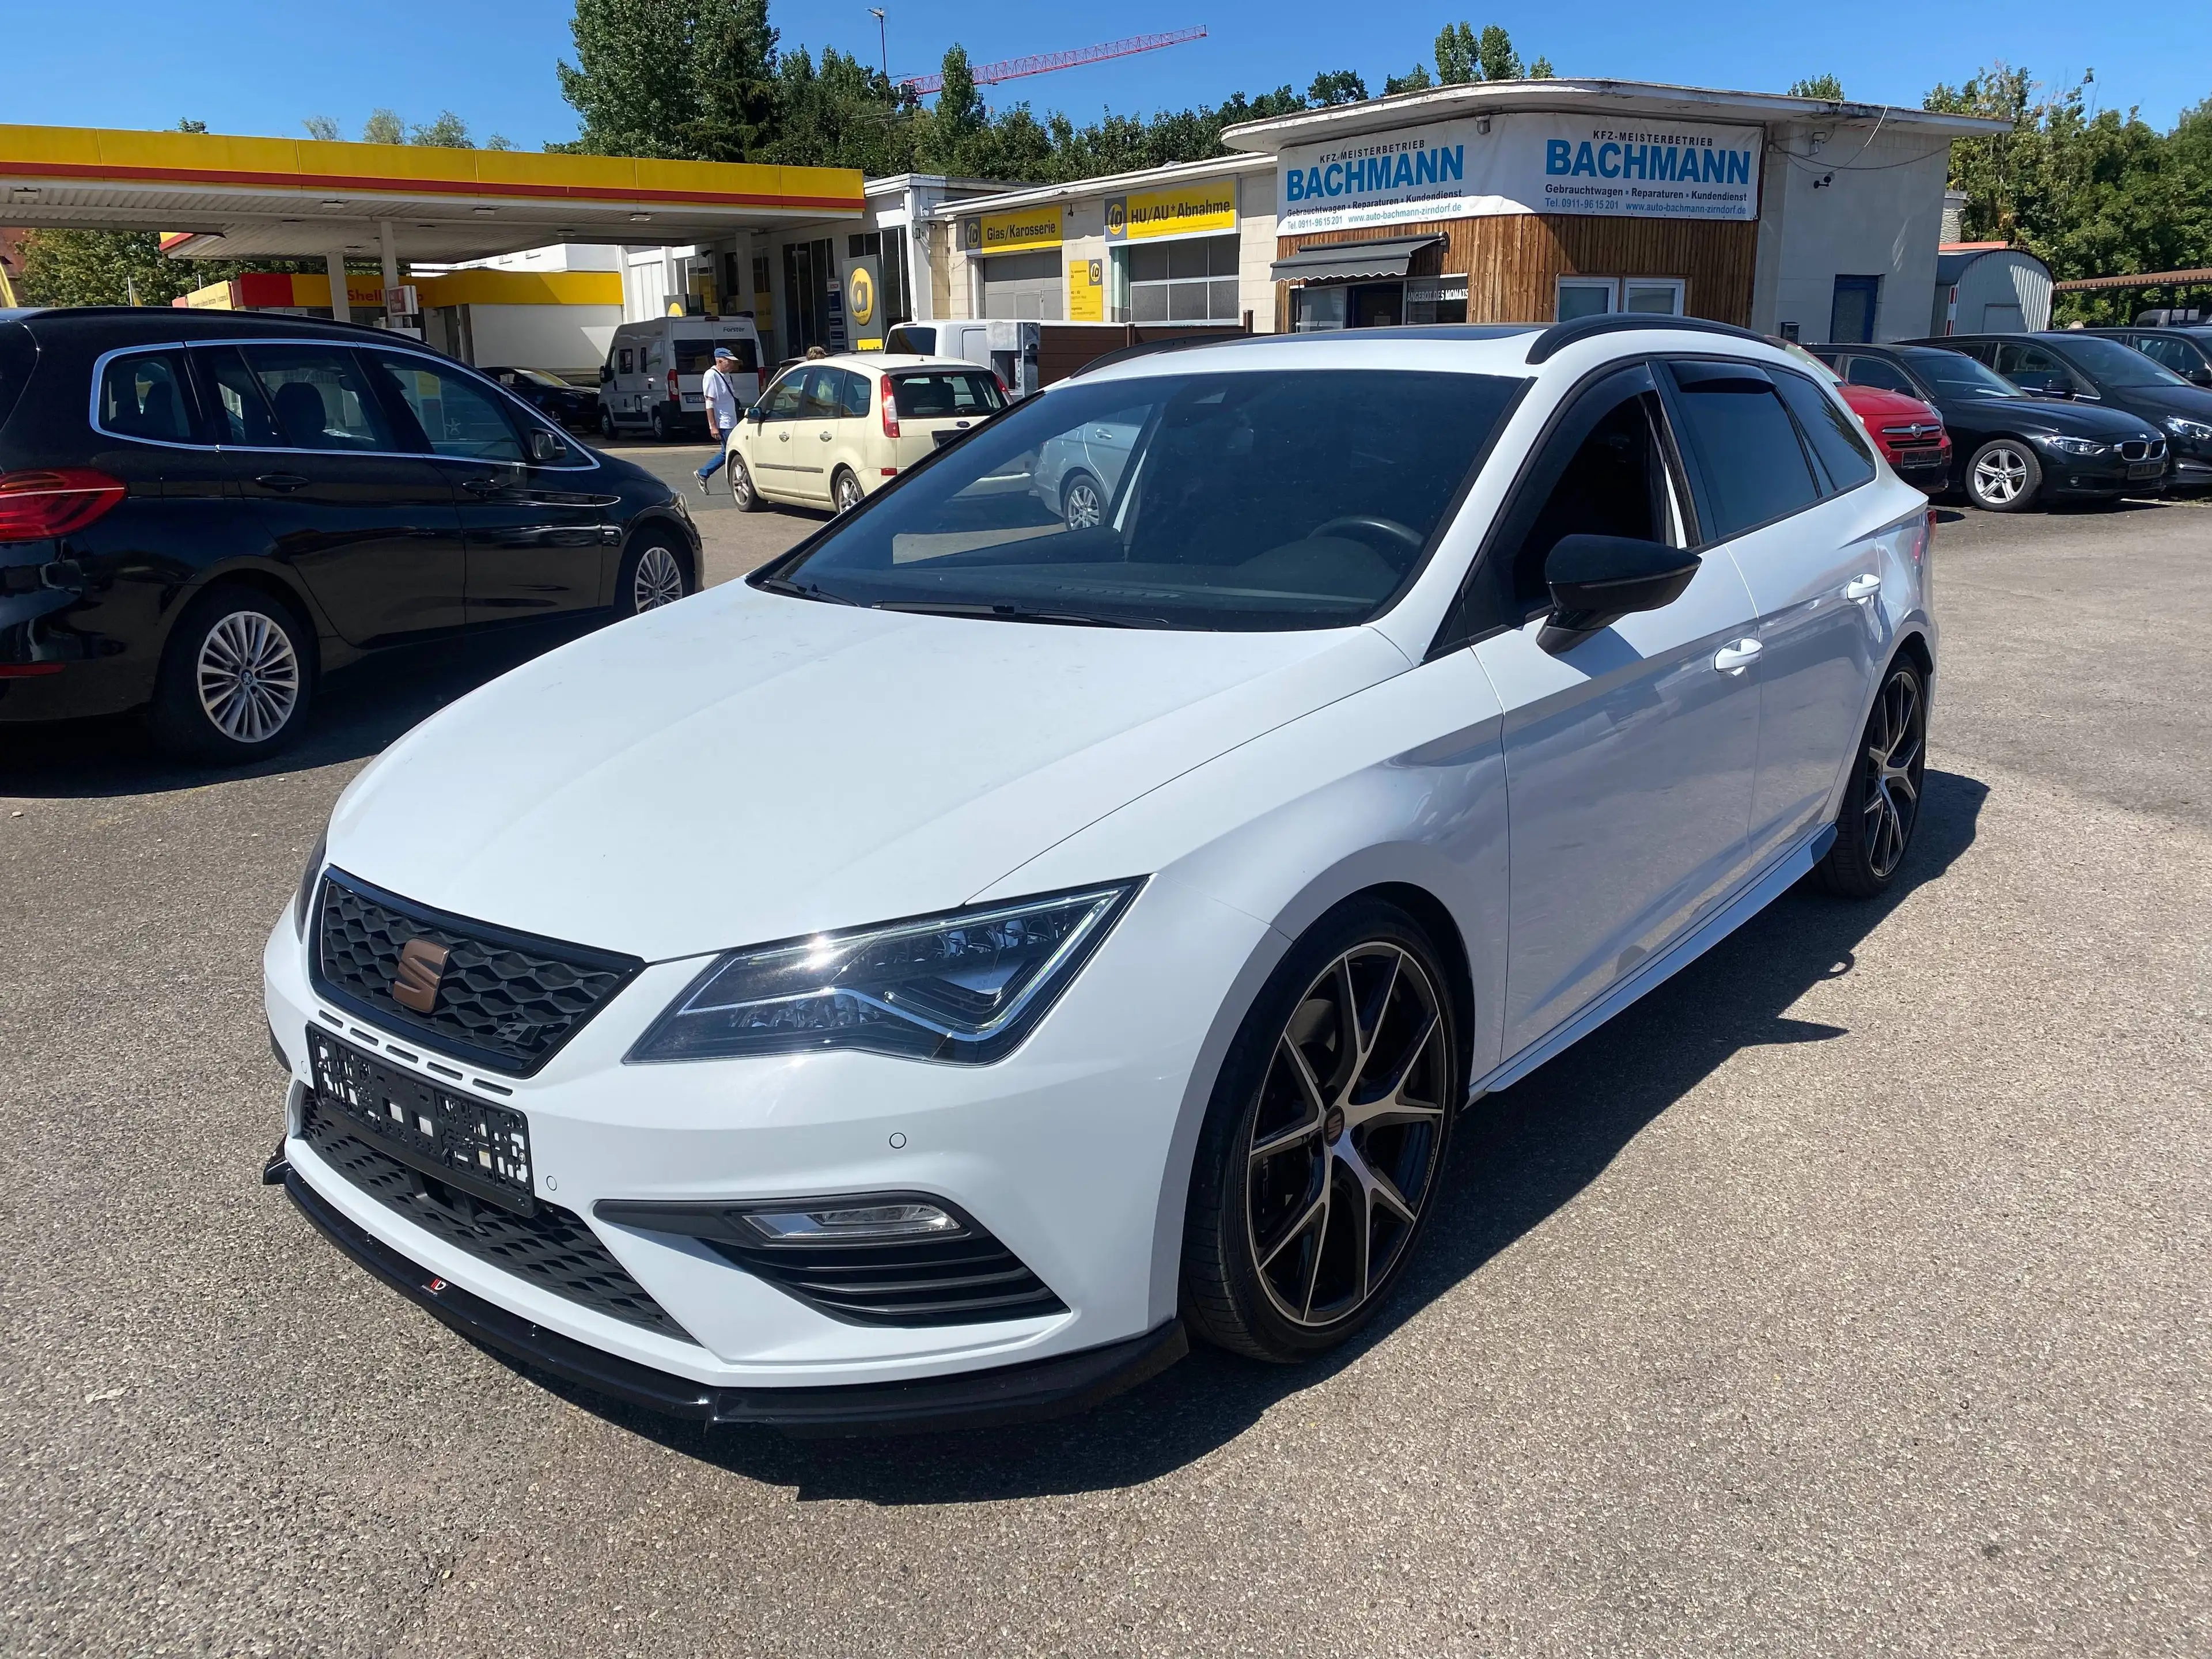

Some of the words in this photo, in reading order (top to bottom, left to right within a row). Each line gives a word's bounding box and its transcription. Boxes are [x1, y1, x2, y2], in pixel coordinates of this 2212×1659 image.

[1593, 130, 1713, 146] KFZ-MEISTERBETRIEB
[1320, 139, 1425, 164] KFZ-MEISTERBETRIEB
[1546, 139, 1751, 184] BACHMANN
[1287, 145, 1464, 202] BACHMANN
[1287, 203, 1346, 217] Gebrauchtwagen
[1353, 198, 1399, 211] Reparaturen
[1406, 188, 1462, 203] Kundendienst
[1545, 184, 1623, 197] Gebrauchtwagen
[1631, 188, 1684, 199] Reparaturen
[1691, 191, 1747, 201] Kundendienst
[1287, 221, 1297, 230] Tel.
[1348, 203, 1462, 223] www.auto-bachmann-zirndorf.de
[1545, 198, 1560, 207] Tel.
[1626, 202, 1747, 215] www.auto-bachmann-zirndorf.de
[987, 220, 1056, 241] Glas/Karosserie
[347, 289, 382, 301] Shell
[1407, 291, 1432, 302] ANGEBOT
[1433, 289, 1445, 301] DES
[1445, 288, 1468, 300] MONATS
